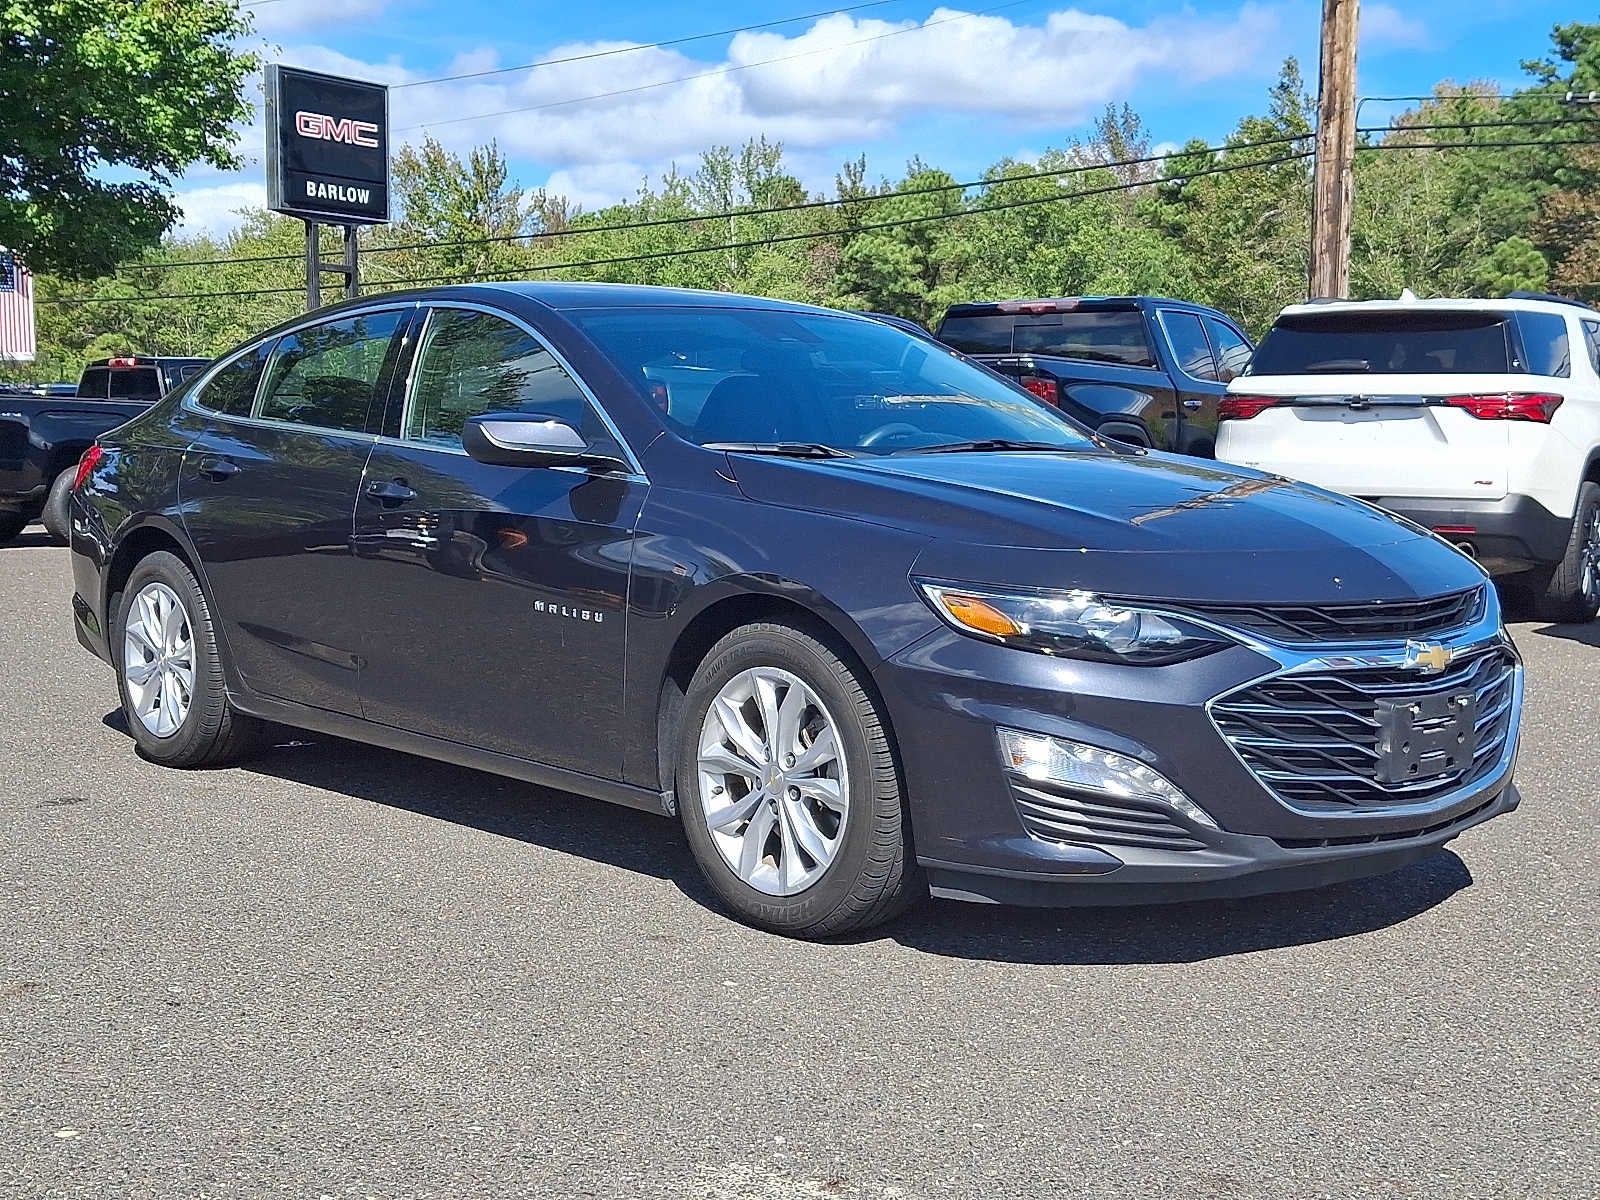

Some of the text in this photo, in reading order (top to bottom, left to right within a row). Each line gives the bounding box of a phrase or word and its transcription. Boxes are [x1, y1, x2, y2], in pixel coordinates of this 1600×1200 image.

[295, 110, 379, 148] GMC
[306, 180, 370, 204] BARLOW
[534, 600, 604, 623] MALIBU
